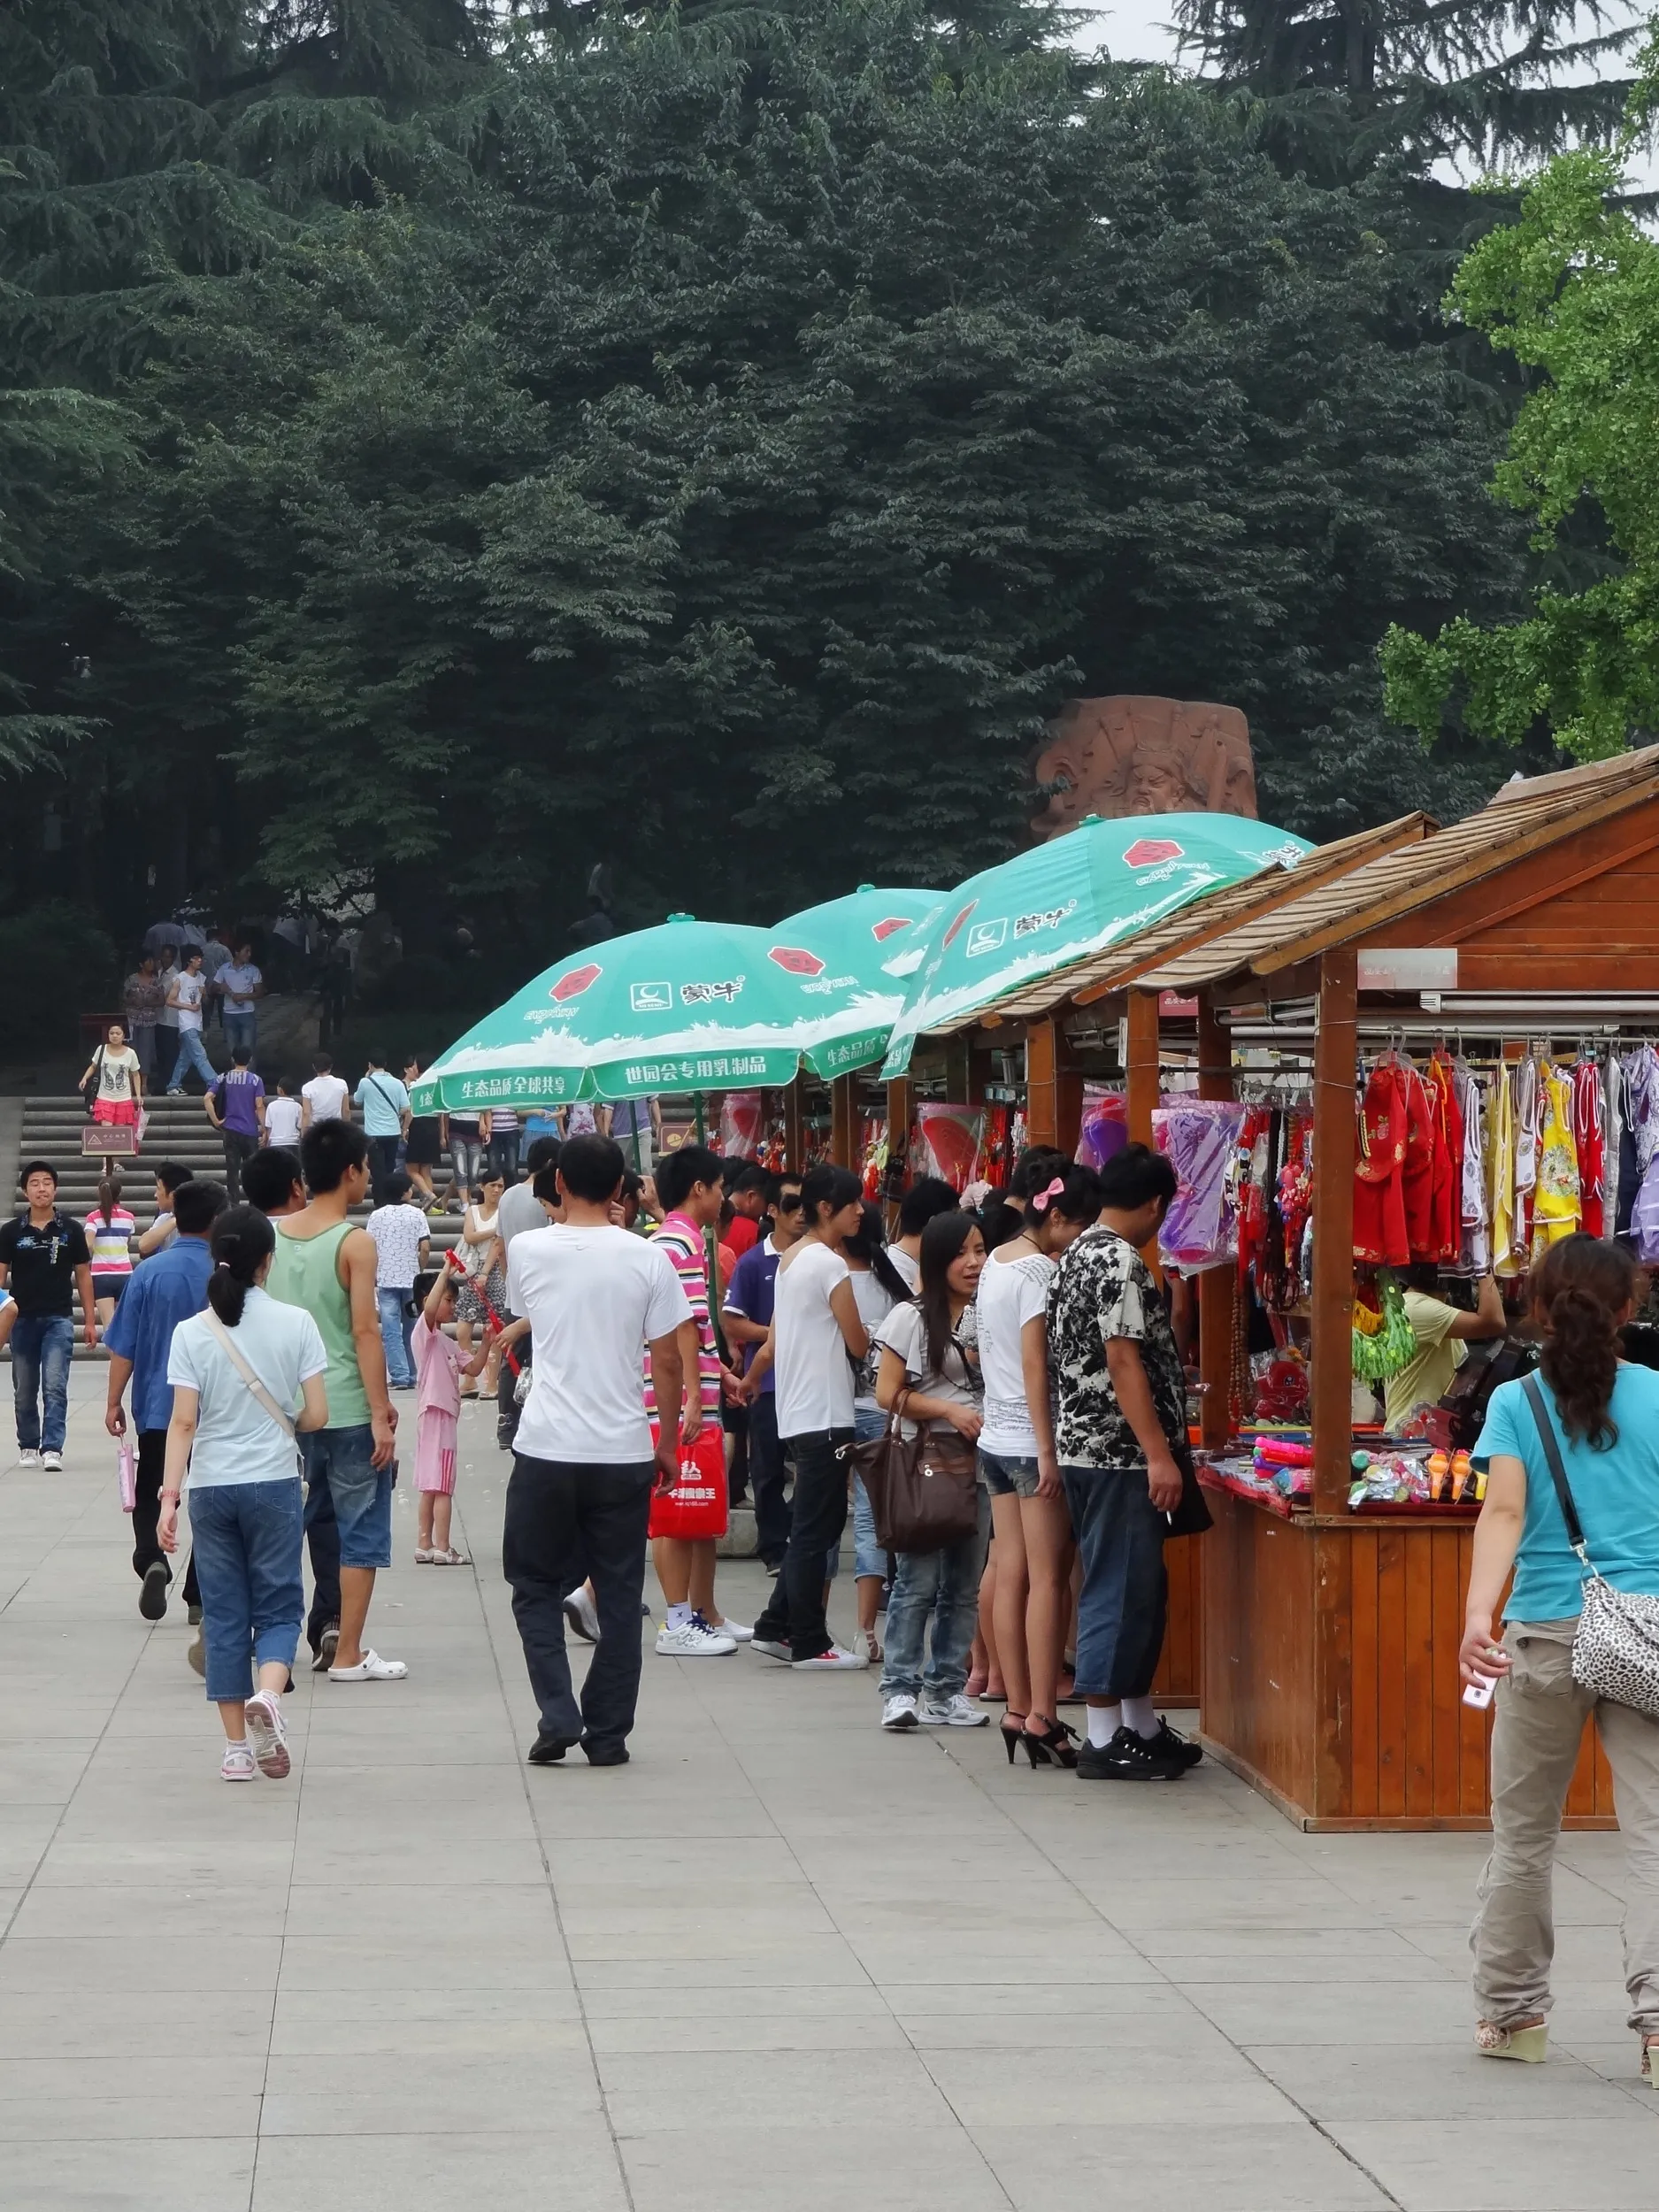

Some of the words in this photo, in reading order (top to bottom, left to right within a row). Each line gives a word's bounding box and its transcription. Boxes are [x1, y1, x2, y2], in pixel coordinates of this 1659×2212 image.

[1013, 908, 1072, 940] 蒙牛
[680, 981, 742, 1005] 蒙牛
[625, 1056, 767, 1085] 世园会专用乳制品
